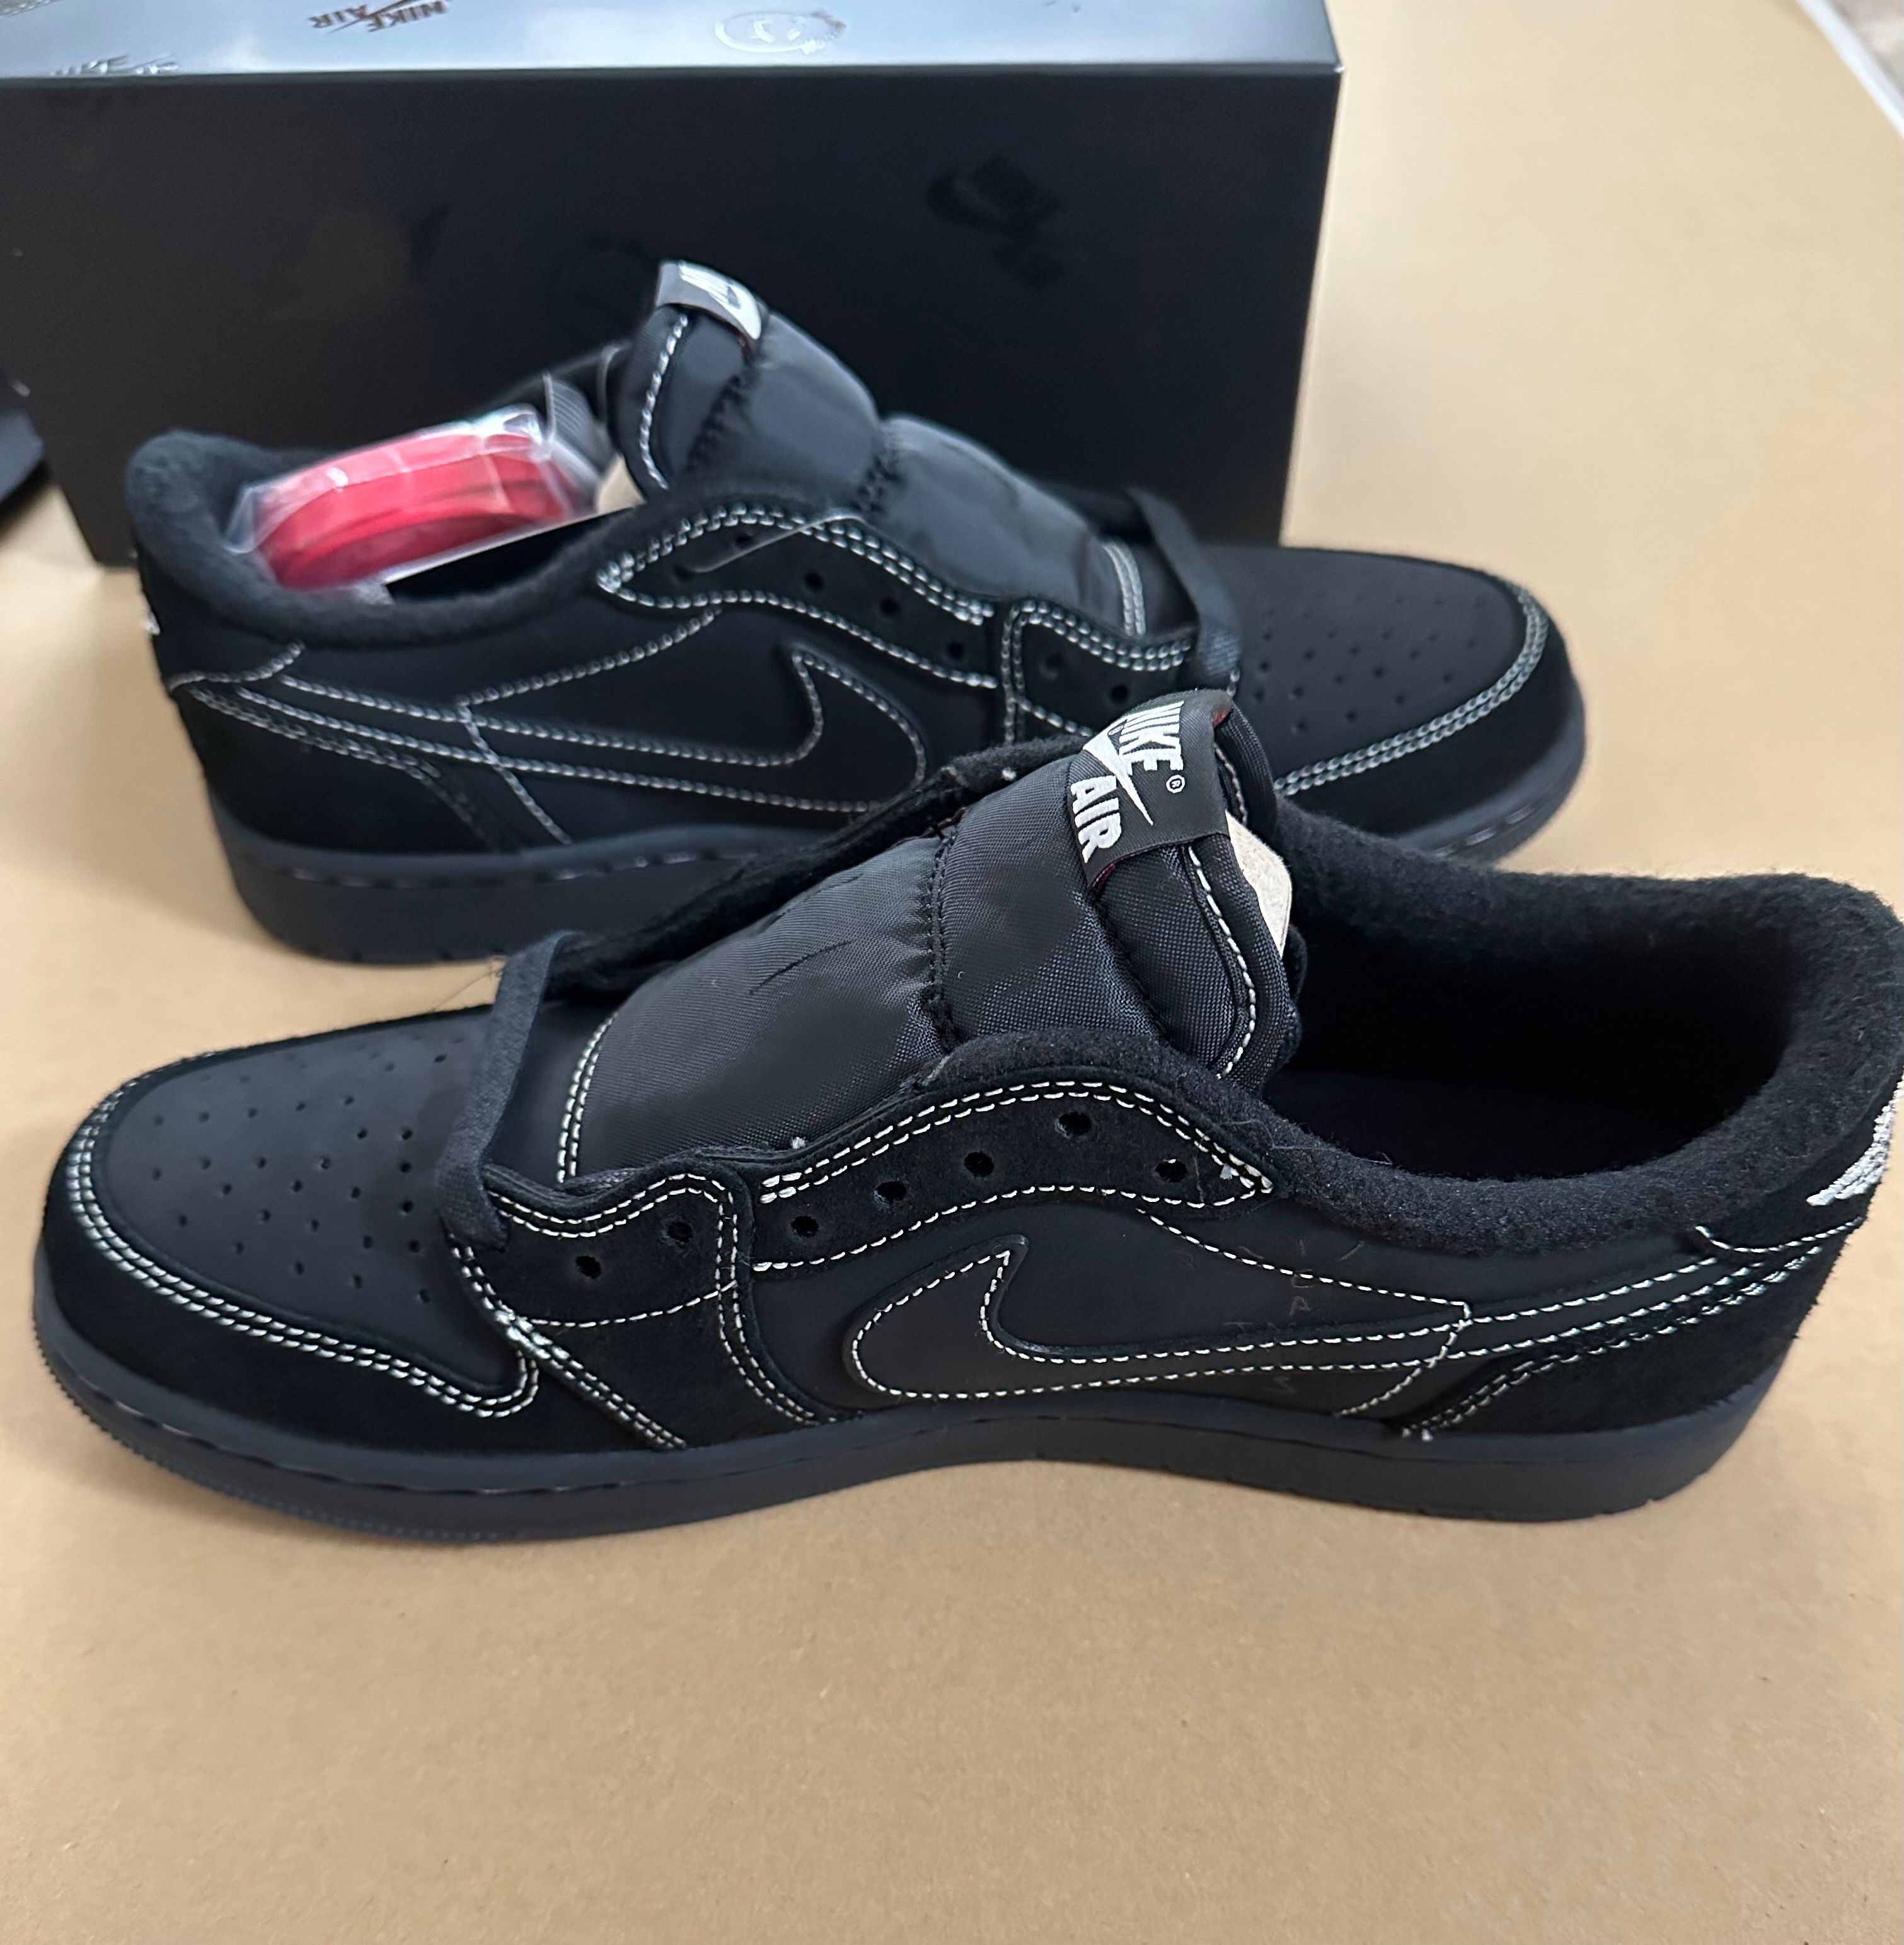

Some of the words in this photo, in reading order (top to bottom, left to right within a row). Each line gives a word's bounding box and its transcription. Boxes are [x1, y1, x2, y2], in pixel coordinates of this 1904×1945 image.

[308, 4, 367, 28] AIR
[367, 1, 447, 32] NIKE
[1118, 701, 1184, 775] NIKE
[1070, 775, 1122, 863] AIR
